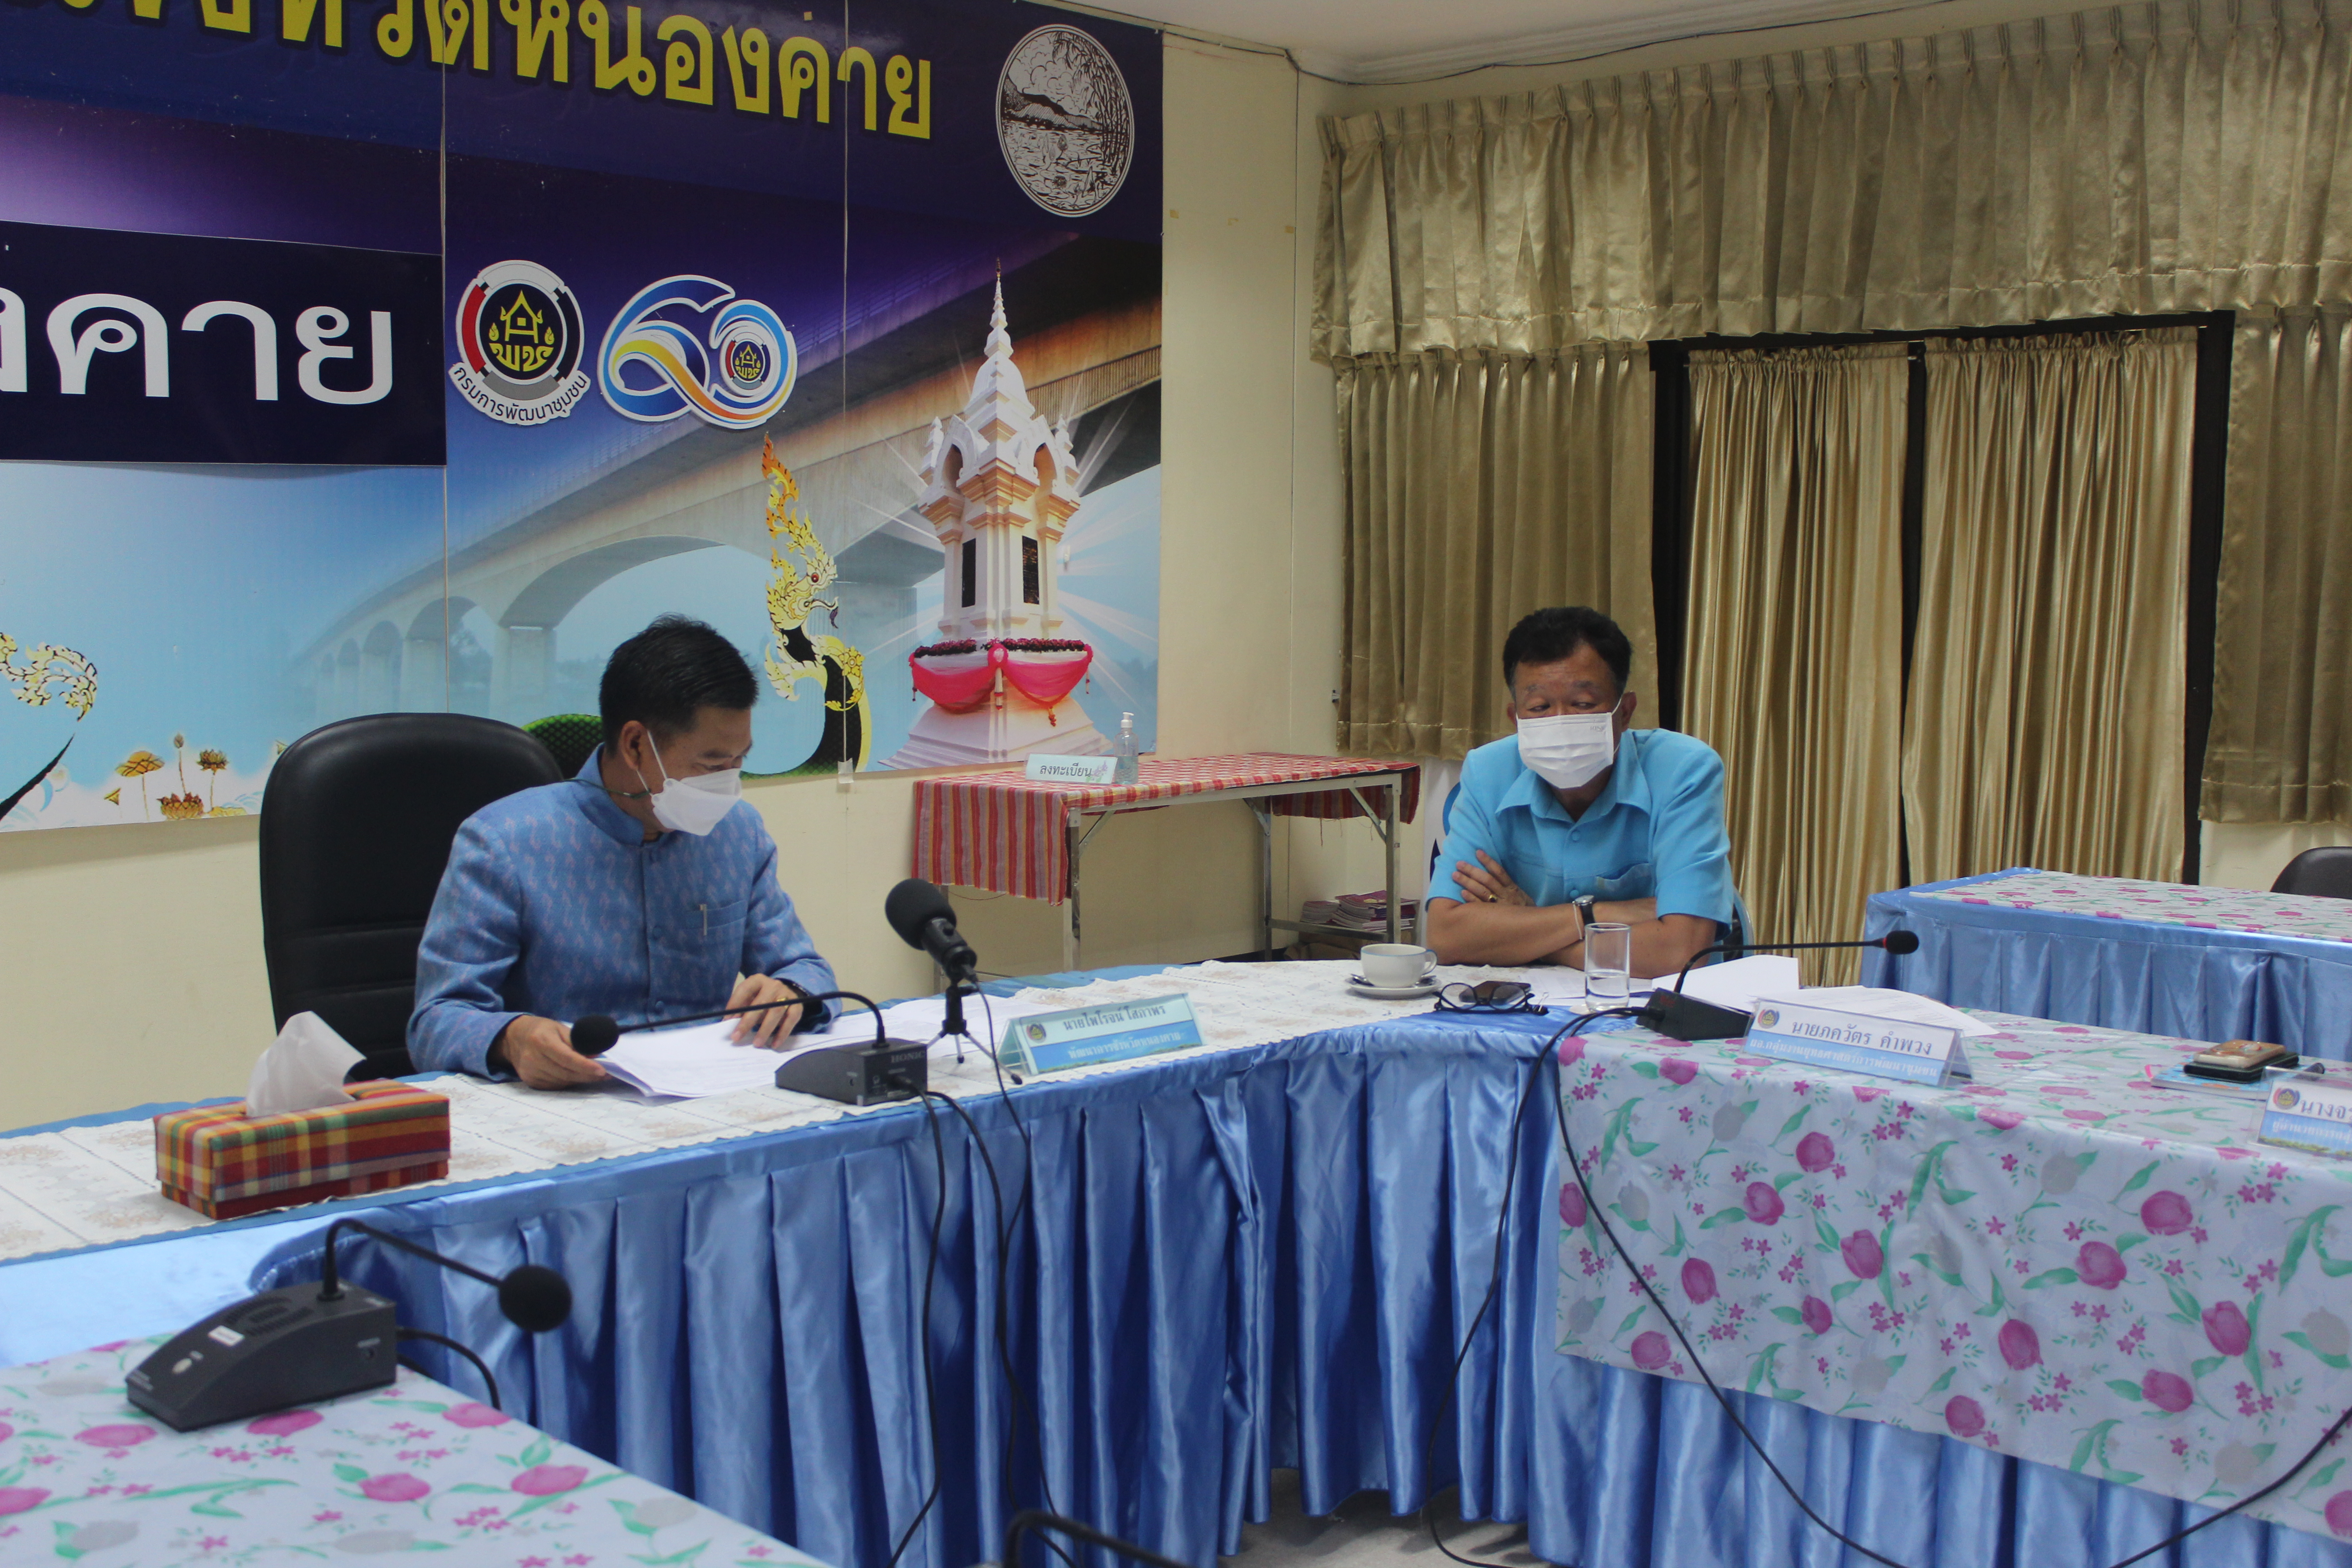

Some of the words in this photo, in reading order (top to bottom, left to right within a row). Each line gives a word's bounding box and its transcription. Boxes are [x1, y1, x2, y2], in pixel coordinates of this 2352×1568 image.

[454, 367, 588, 421] กรมการพัฒนาชุมชน
[1039, 762, 1093, 778] ลงทะเบียน
[1792, 1021, 1872, 1045] นายภควัตร
[1879, 1030, 1932, 1055] คำพวง
